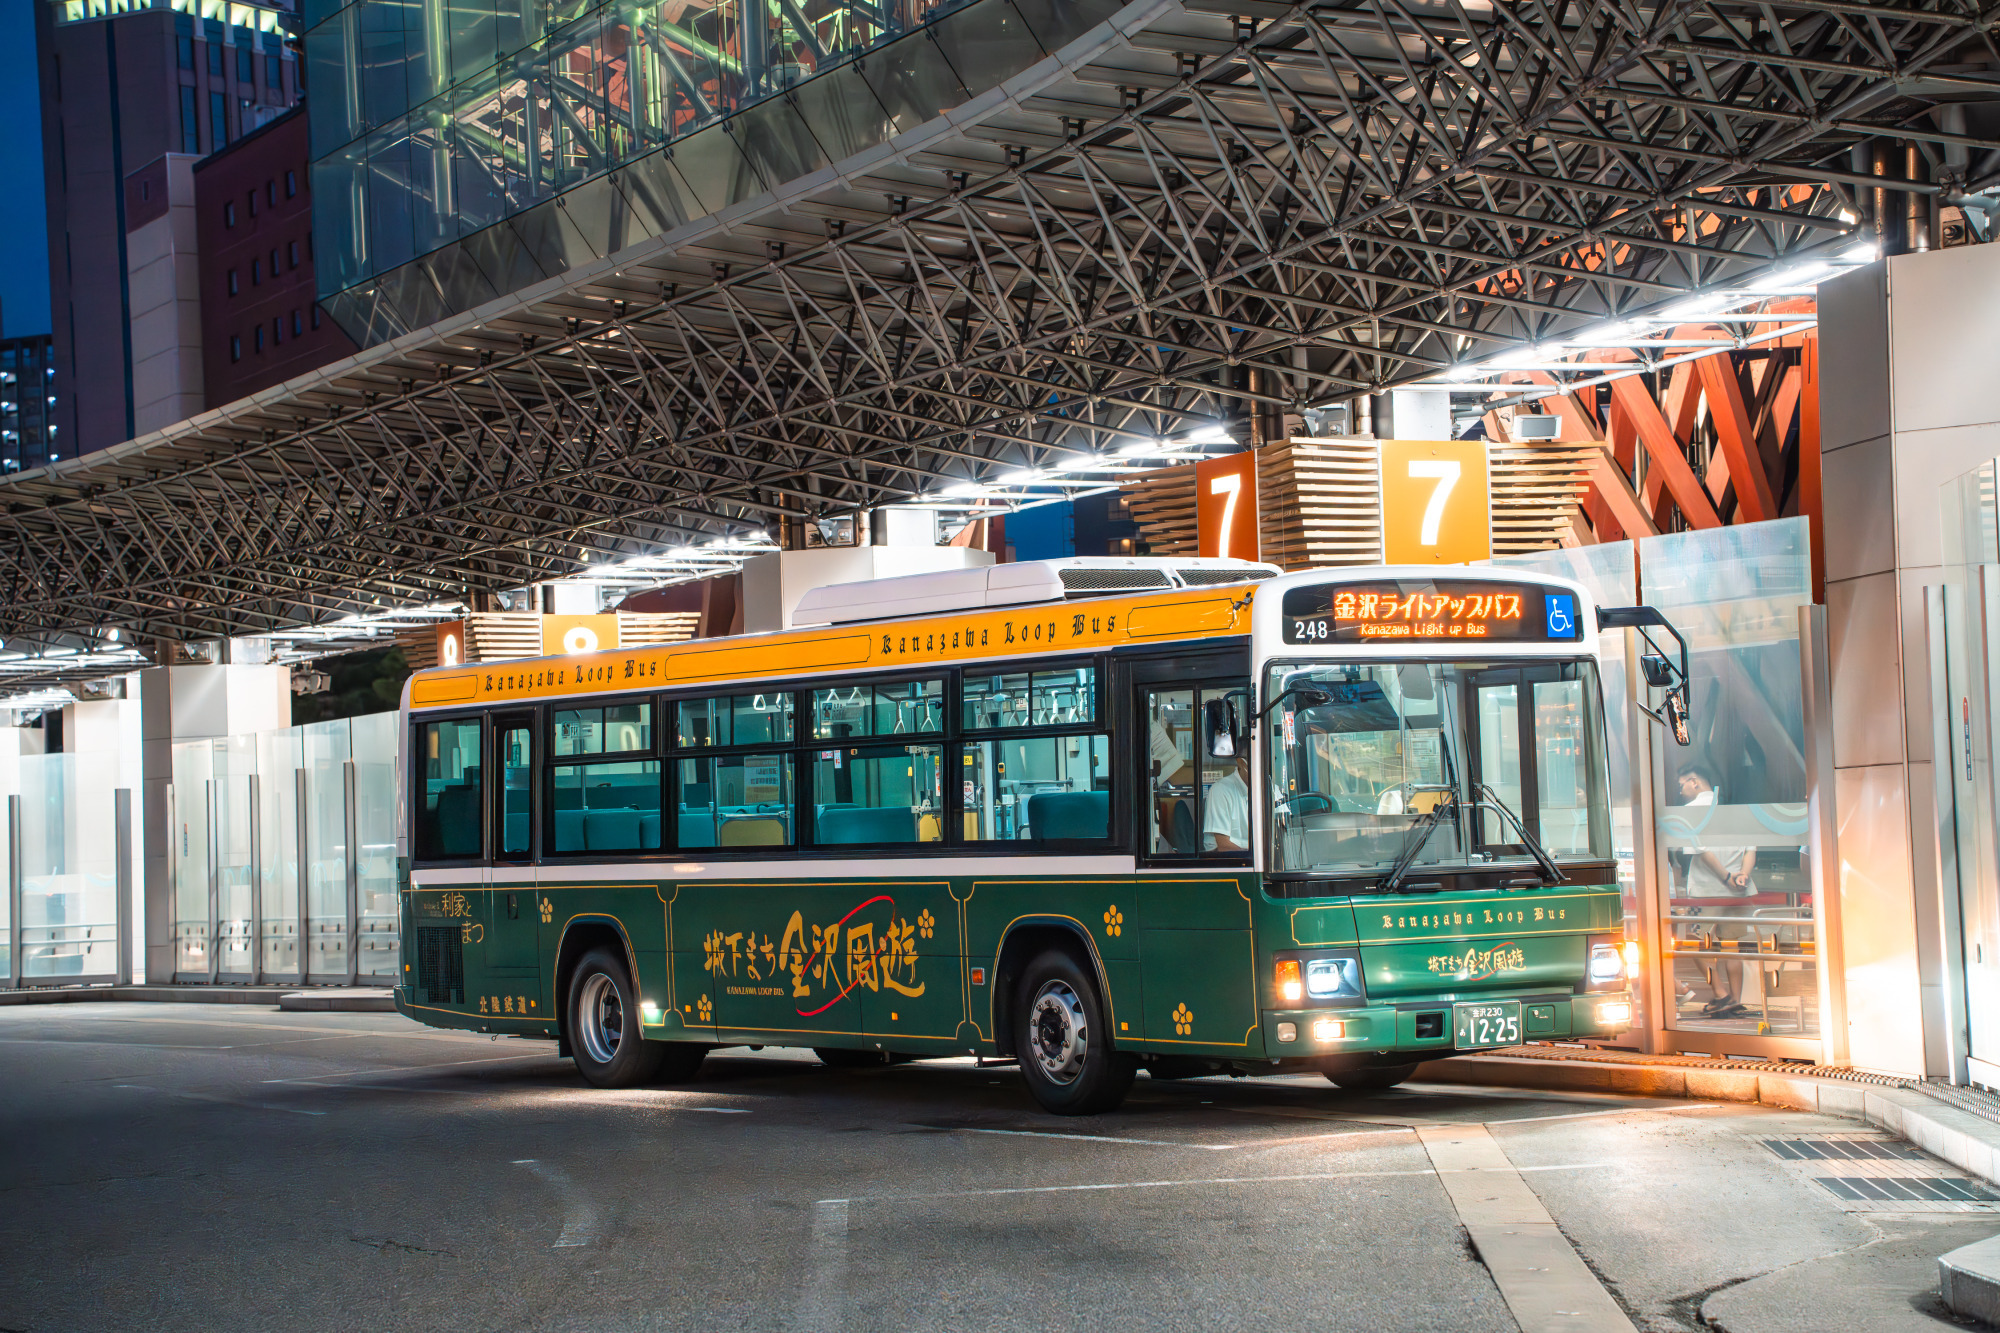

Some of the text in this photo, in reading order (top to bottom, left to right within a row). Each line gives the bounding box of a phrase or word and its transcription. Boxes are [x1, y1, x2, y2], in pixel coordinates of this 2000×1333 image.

[1211, 473, 1241, 558] 7
[1408, 460, 1461, 546] 7
[1334, 592, 1521, 619] 金沢ライトアップバス
[880, 614, 1116, 654] Kanazawa Loop Bus
[1295, 621, 1328, 639] 248
[1361, 623, 1485, 636] Kanazawa Light up Bus
[484, 659, 657, 692] Kanazawa Loop Bus
[441, 892, 472, 917] 利家と
[1382, 907, 1566, 929] Kanazawa Loop Bus
[461, 921, 484, 944] まつ
[1470, 1017, 1518, 1044] 12-25
